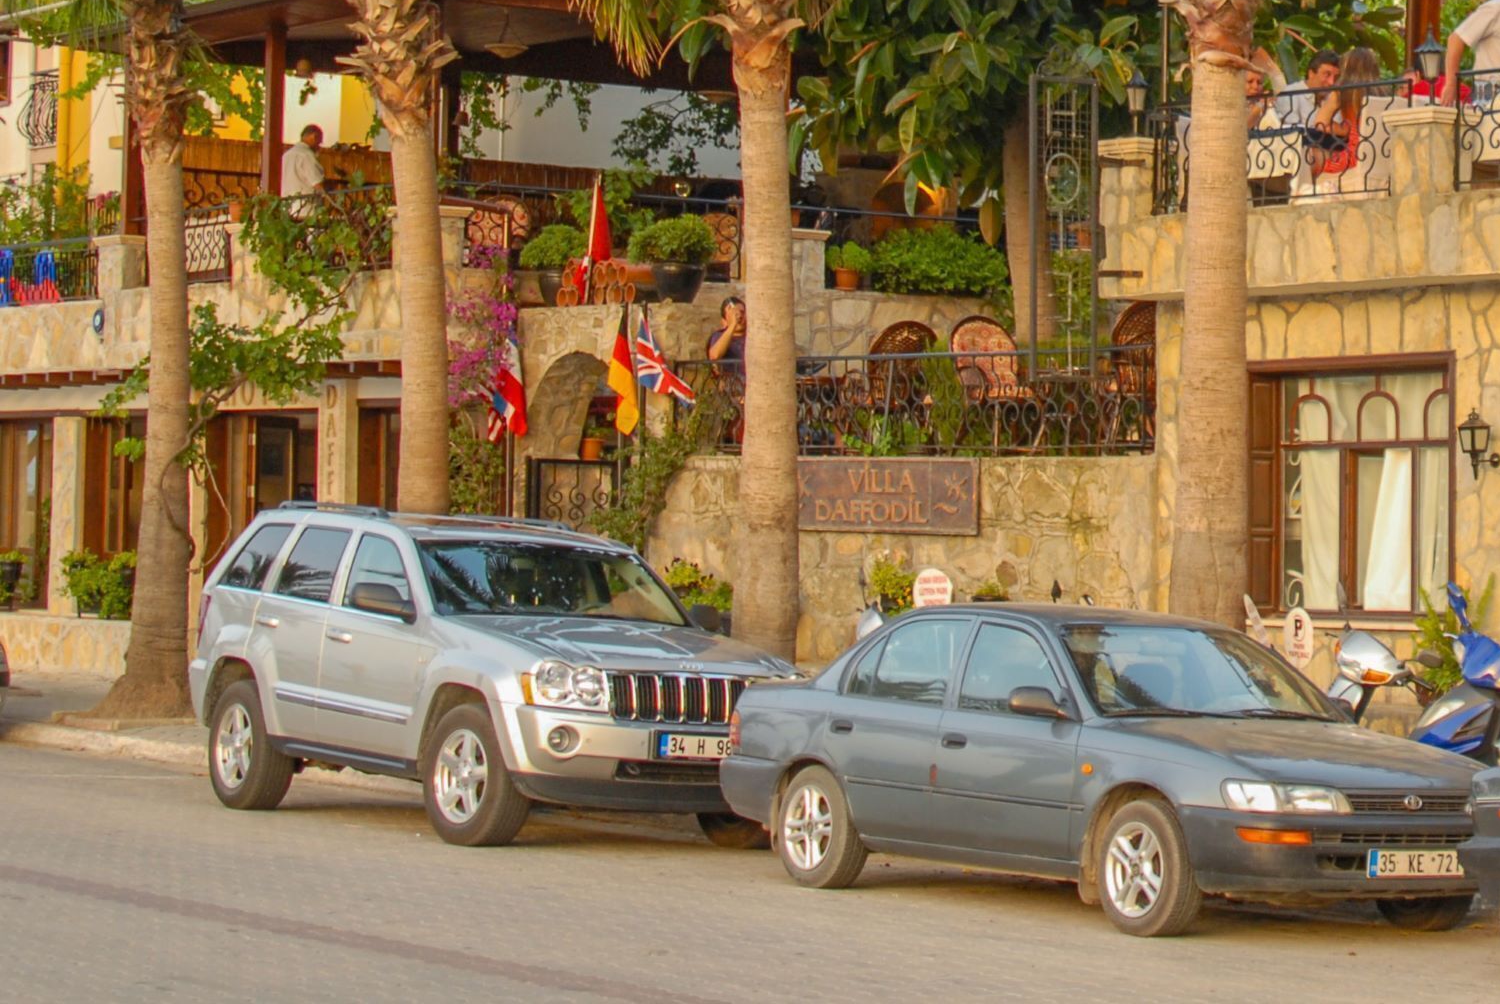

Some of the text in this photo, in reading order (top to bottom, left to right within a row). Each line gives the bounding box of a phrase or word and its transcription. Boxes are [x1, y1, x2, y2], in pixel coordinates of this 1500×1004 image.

[326, 384, 338, 502] DAFF
[1294, 619, 1303, 637] P
[671, 737, 685, 754] 34
[697, 738, 706, 755] H
[1380, 853, 1396, 873] 35
[1408, 854, 1424, 873] KE
